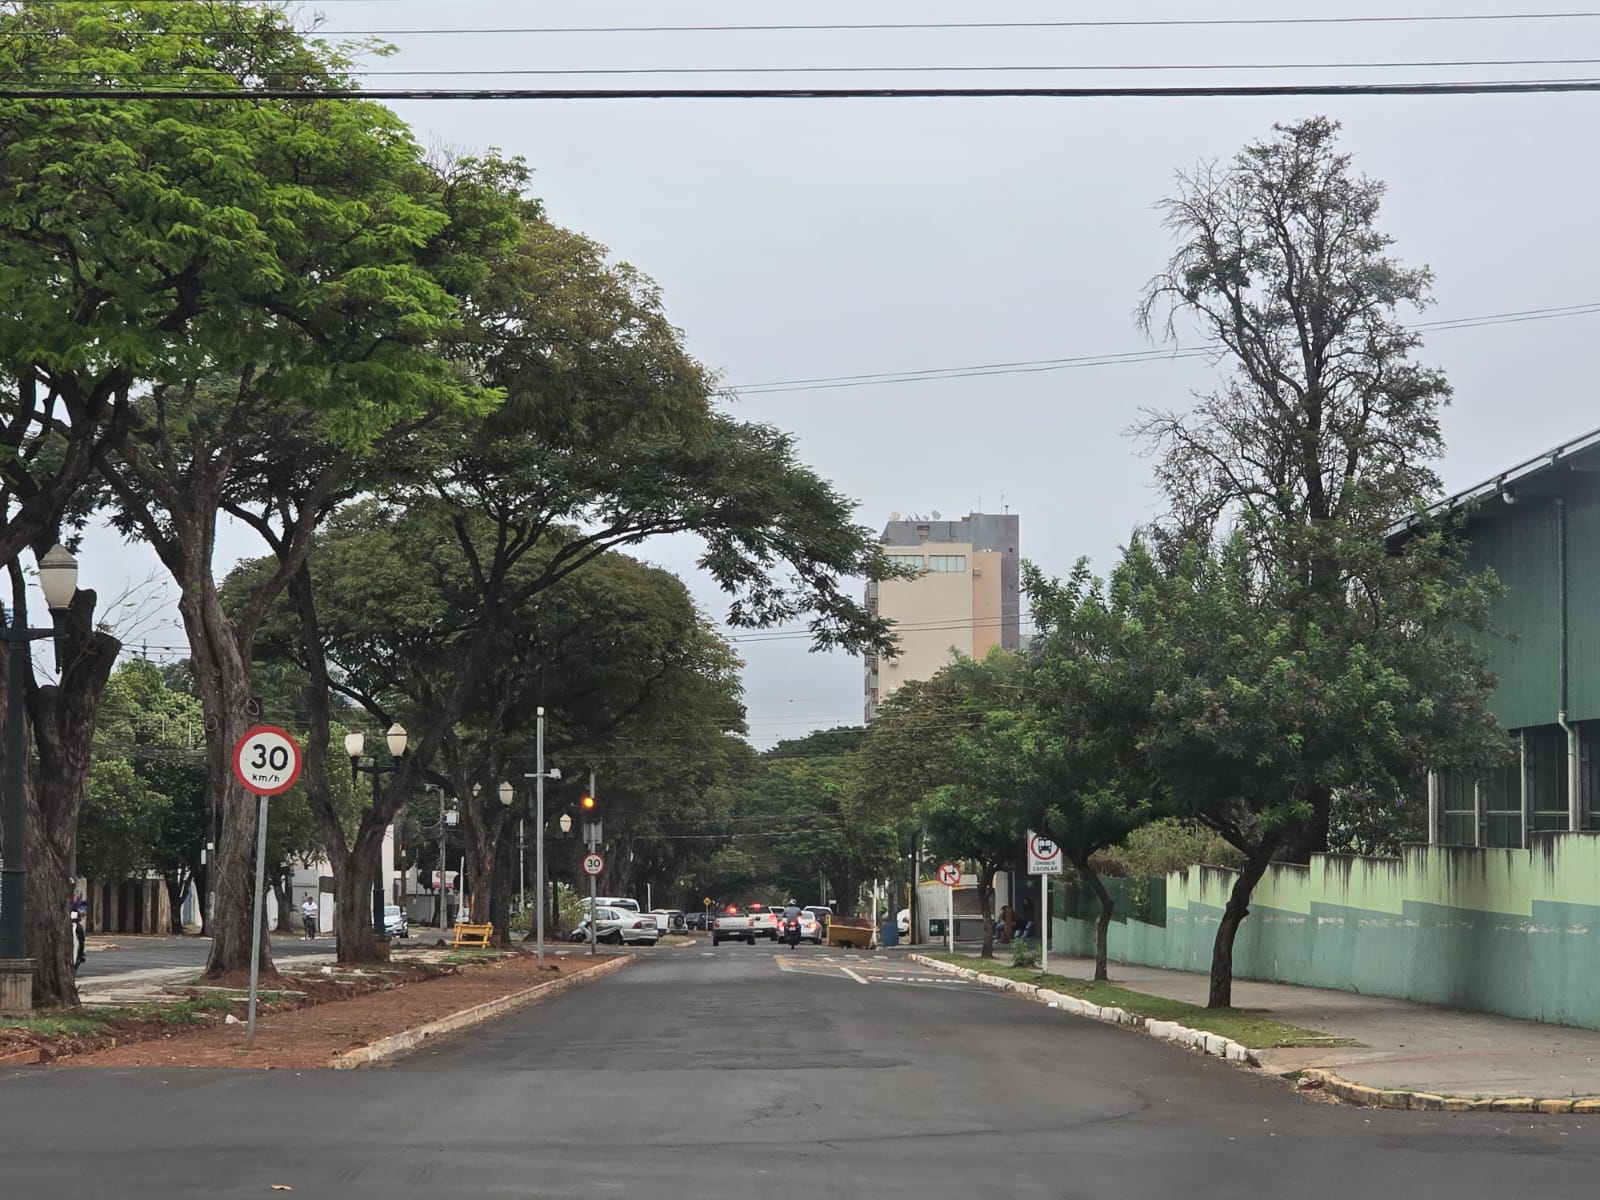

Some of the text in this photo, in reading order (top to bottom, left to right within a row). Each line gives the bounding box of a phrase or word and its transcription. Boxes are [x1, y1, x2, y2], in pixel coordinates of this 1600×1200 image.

[251, 744, 288, 771] 30
[252, 773, 280, 782] km/h
[587, 858, 601, 868] 30
